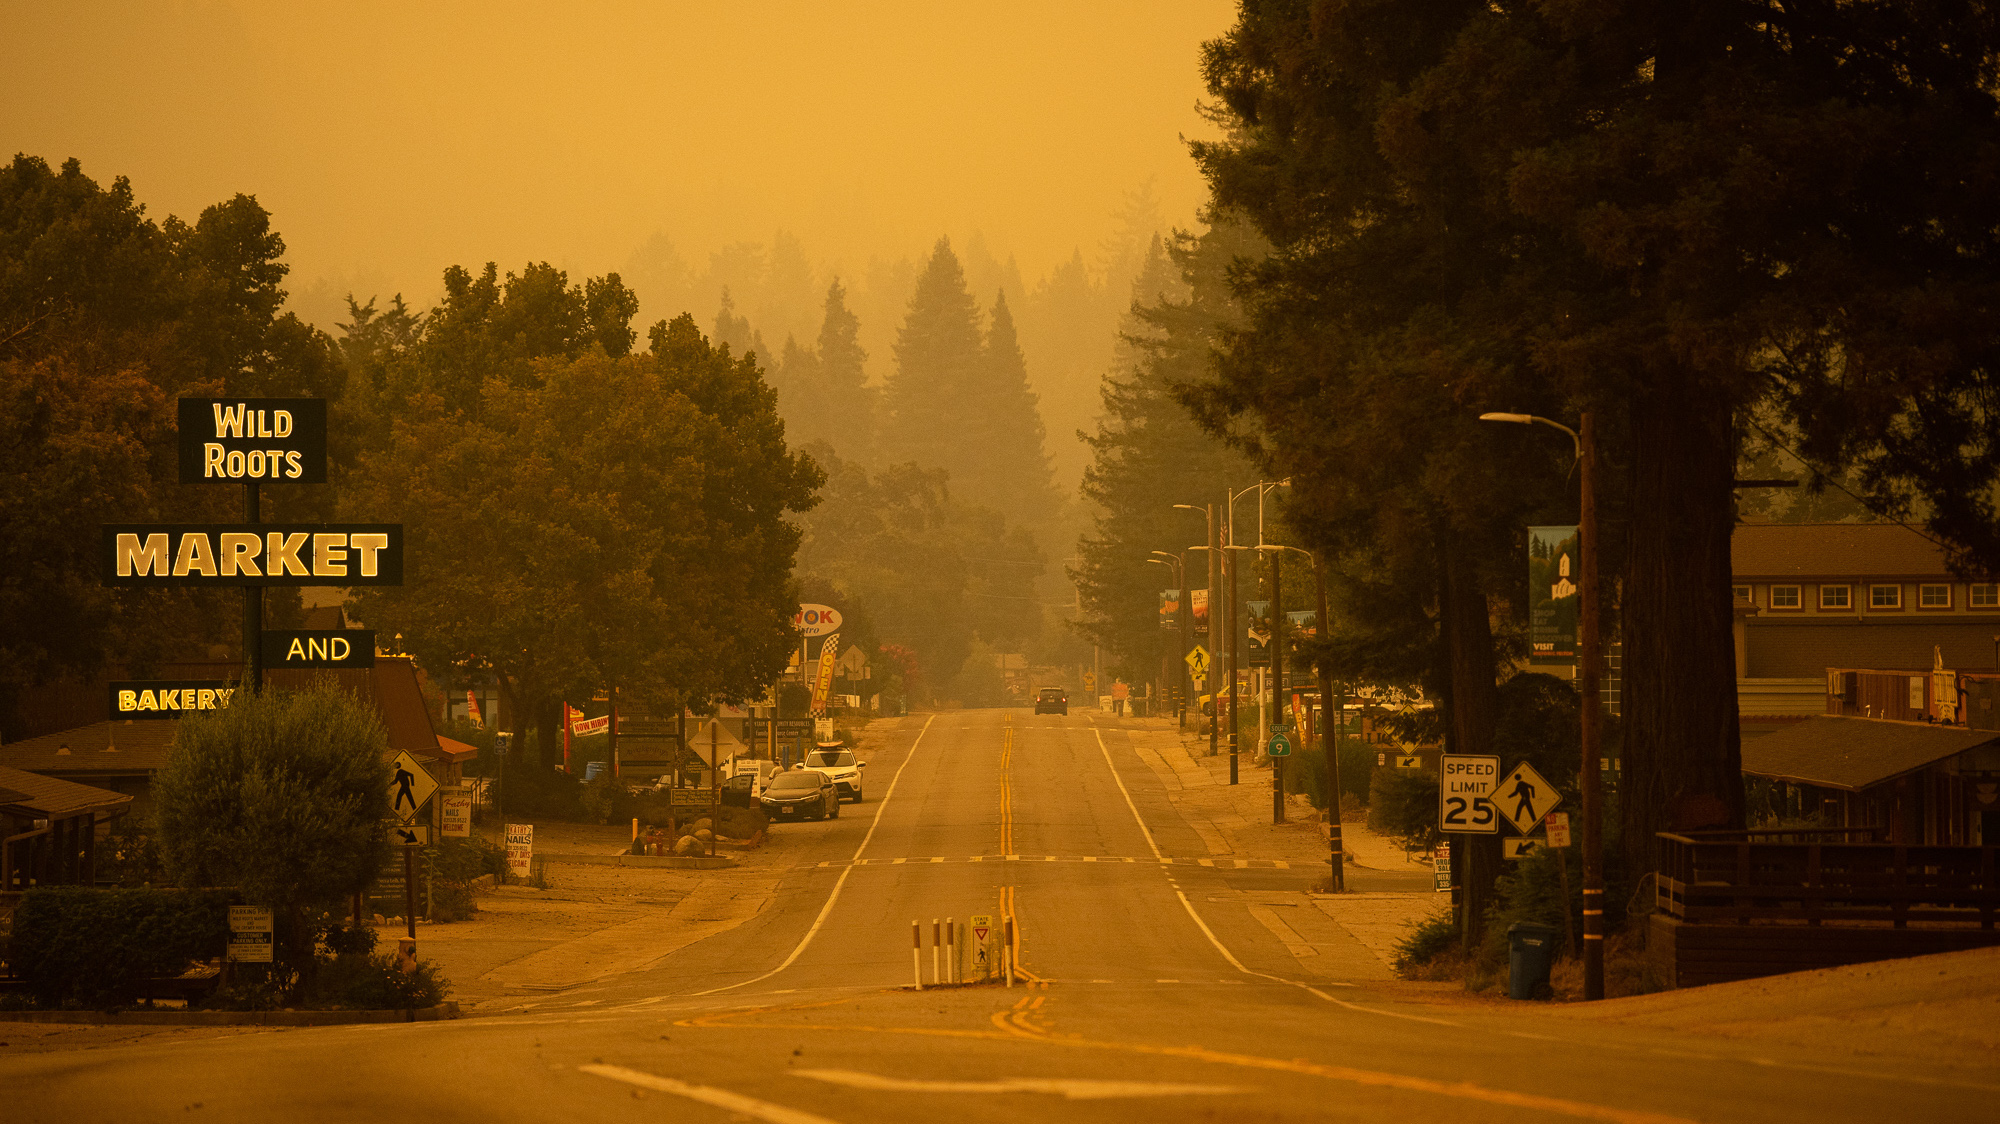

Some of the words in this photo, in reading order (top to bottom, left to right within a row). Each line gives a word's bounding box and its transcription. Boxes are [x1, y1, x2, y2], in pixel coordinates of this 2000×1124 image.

[212, 403, 293, 438] WILD
[203, 443, 303, 478] ROOTS
[116, 532, 388, 577] MARKET
[285, 637, 351, 661] AND
[816, 653, 835, 702] OPEN
[118, 688, 235, 712] BAKERY
[574, 722, 591, 732] NOW
[1275, 743, 1283, 754] 9
[1446, 763, 1494, 775] SPEED
[1451, 781, 1488, 793] LIMIT
[443, 797, 470, 809] Kathy
[445, 809, 459, 817] NAILS
[1445, 797, 1493, 825] 25
[1546, 816, 1556, 824] NO
[443, 823, 464, 832] WELCOME
[1547, 824, 1568, 832] PARKING
[505, 835, 531, 845] NAILS
